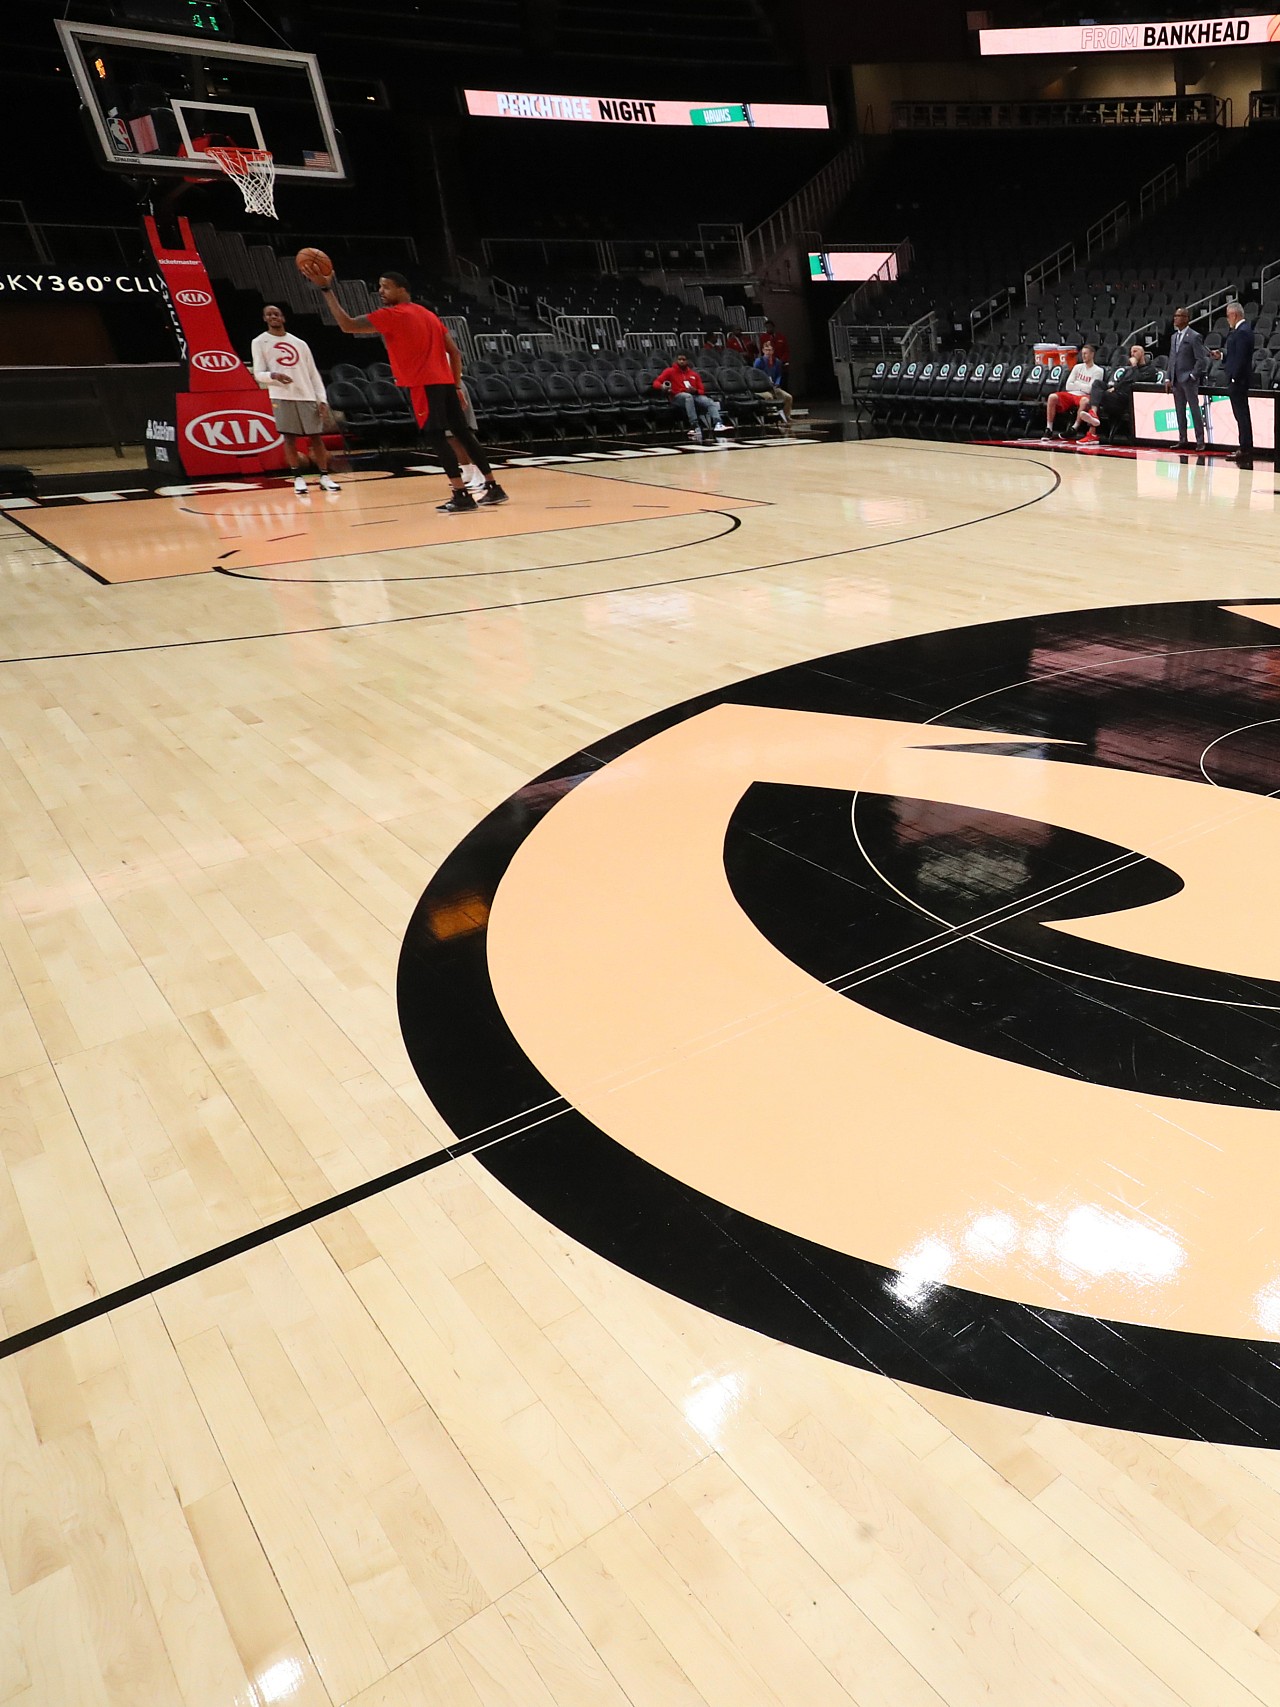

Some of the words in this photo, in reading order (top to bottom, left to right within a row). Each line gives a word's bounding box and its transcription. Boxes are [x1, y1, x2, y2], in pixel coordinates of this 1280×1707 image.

[1081, 26, 1139, 49] FROM
[1143, 20, 1250, 46] BANKHEAD
[497, 94, 593, 120] PEACHTREE
[598, 100, 656, 123] NIGHT
[703, 109, 731, 123] HAWKS
[181, 291, 206, 303] KIA
[200, 355, 233, 368] KIA
[200, 420, 275, 446] KIA
